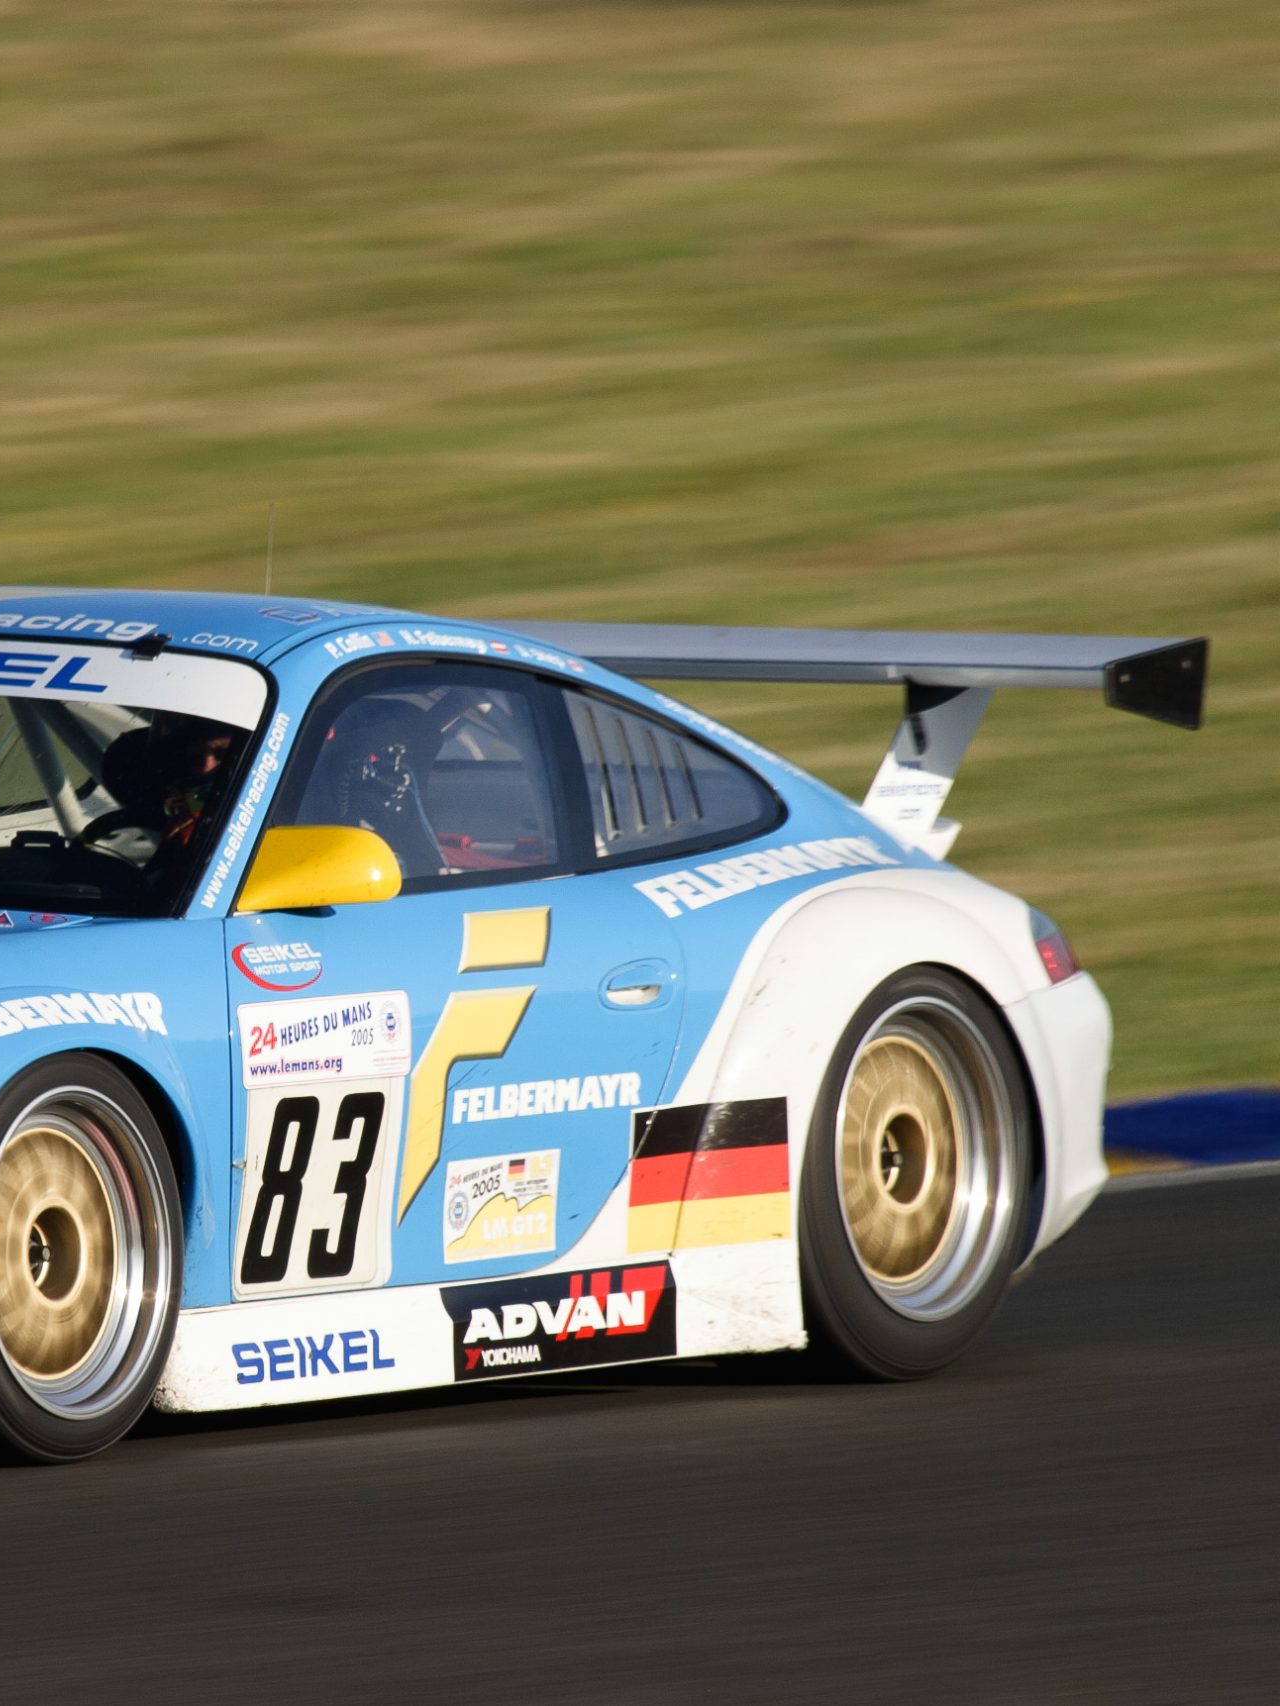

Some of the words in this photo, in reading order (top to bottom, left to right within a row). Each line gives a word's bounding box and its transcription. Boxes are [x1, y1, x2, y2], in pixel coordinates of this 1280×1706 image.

[182, 632, 259, 653] .com
[201, 712, 291, 909] www.seikelracing.com
[242, 942, 322, 964] SEIKEL
[254, 965, 289, 976] MOTOR
[291, 960, 321, 972] SPORT
[249, 1022, 277, 1057] 24
[280, 1018, 320, 1047] HEURES
[323, 1012, 338, 1033] DU
[341, 1001, 372, 1026] MANS
[351, 1027, 374, 1046] 2005
[250, 1056, 343, 1076] www.lemans.org
[452, 1072, 641, 1124] FELBERMAYR
[240, 1092, 386, 1284] 83
[472, 1174, 501, 1199] 2005
[482, 1217, 508, 1240] LM
[512, 1212, 547, 1236] GT2
[463, 1290, 645, 1344] ADVAN
[231, 1329, 396, 1385] SEIKEL
[482, 1344, 542, 1368] YOKOHAMA
